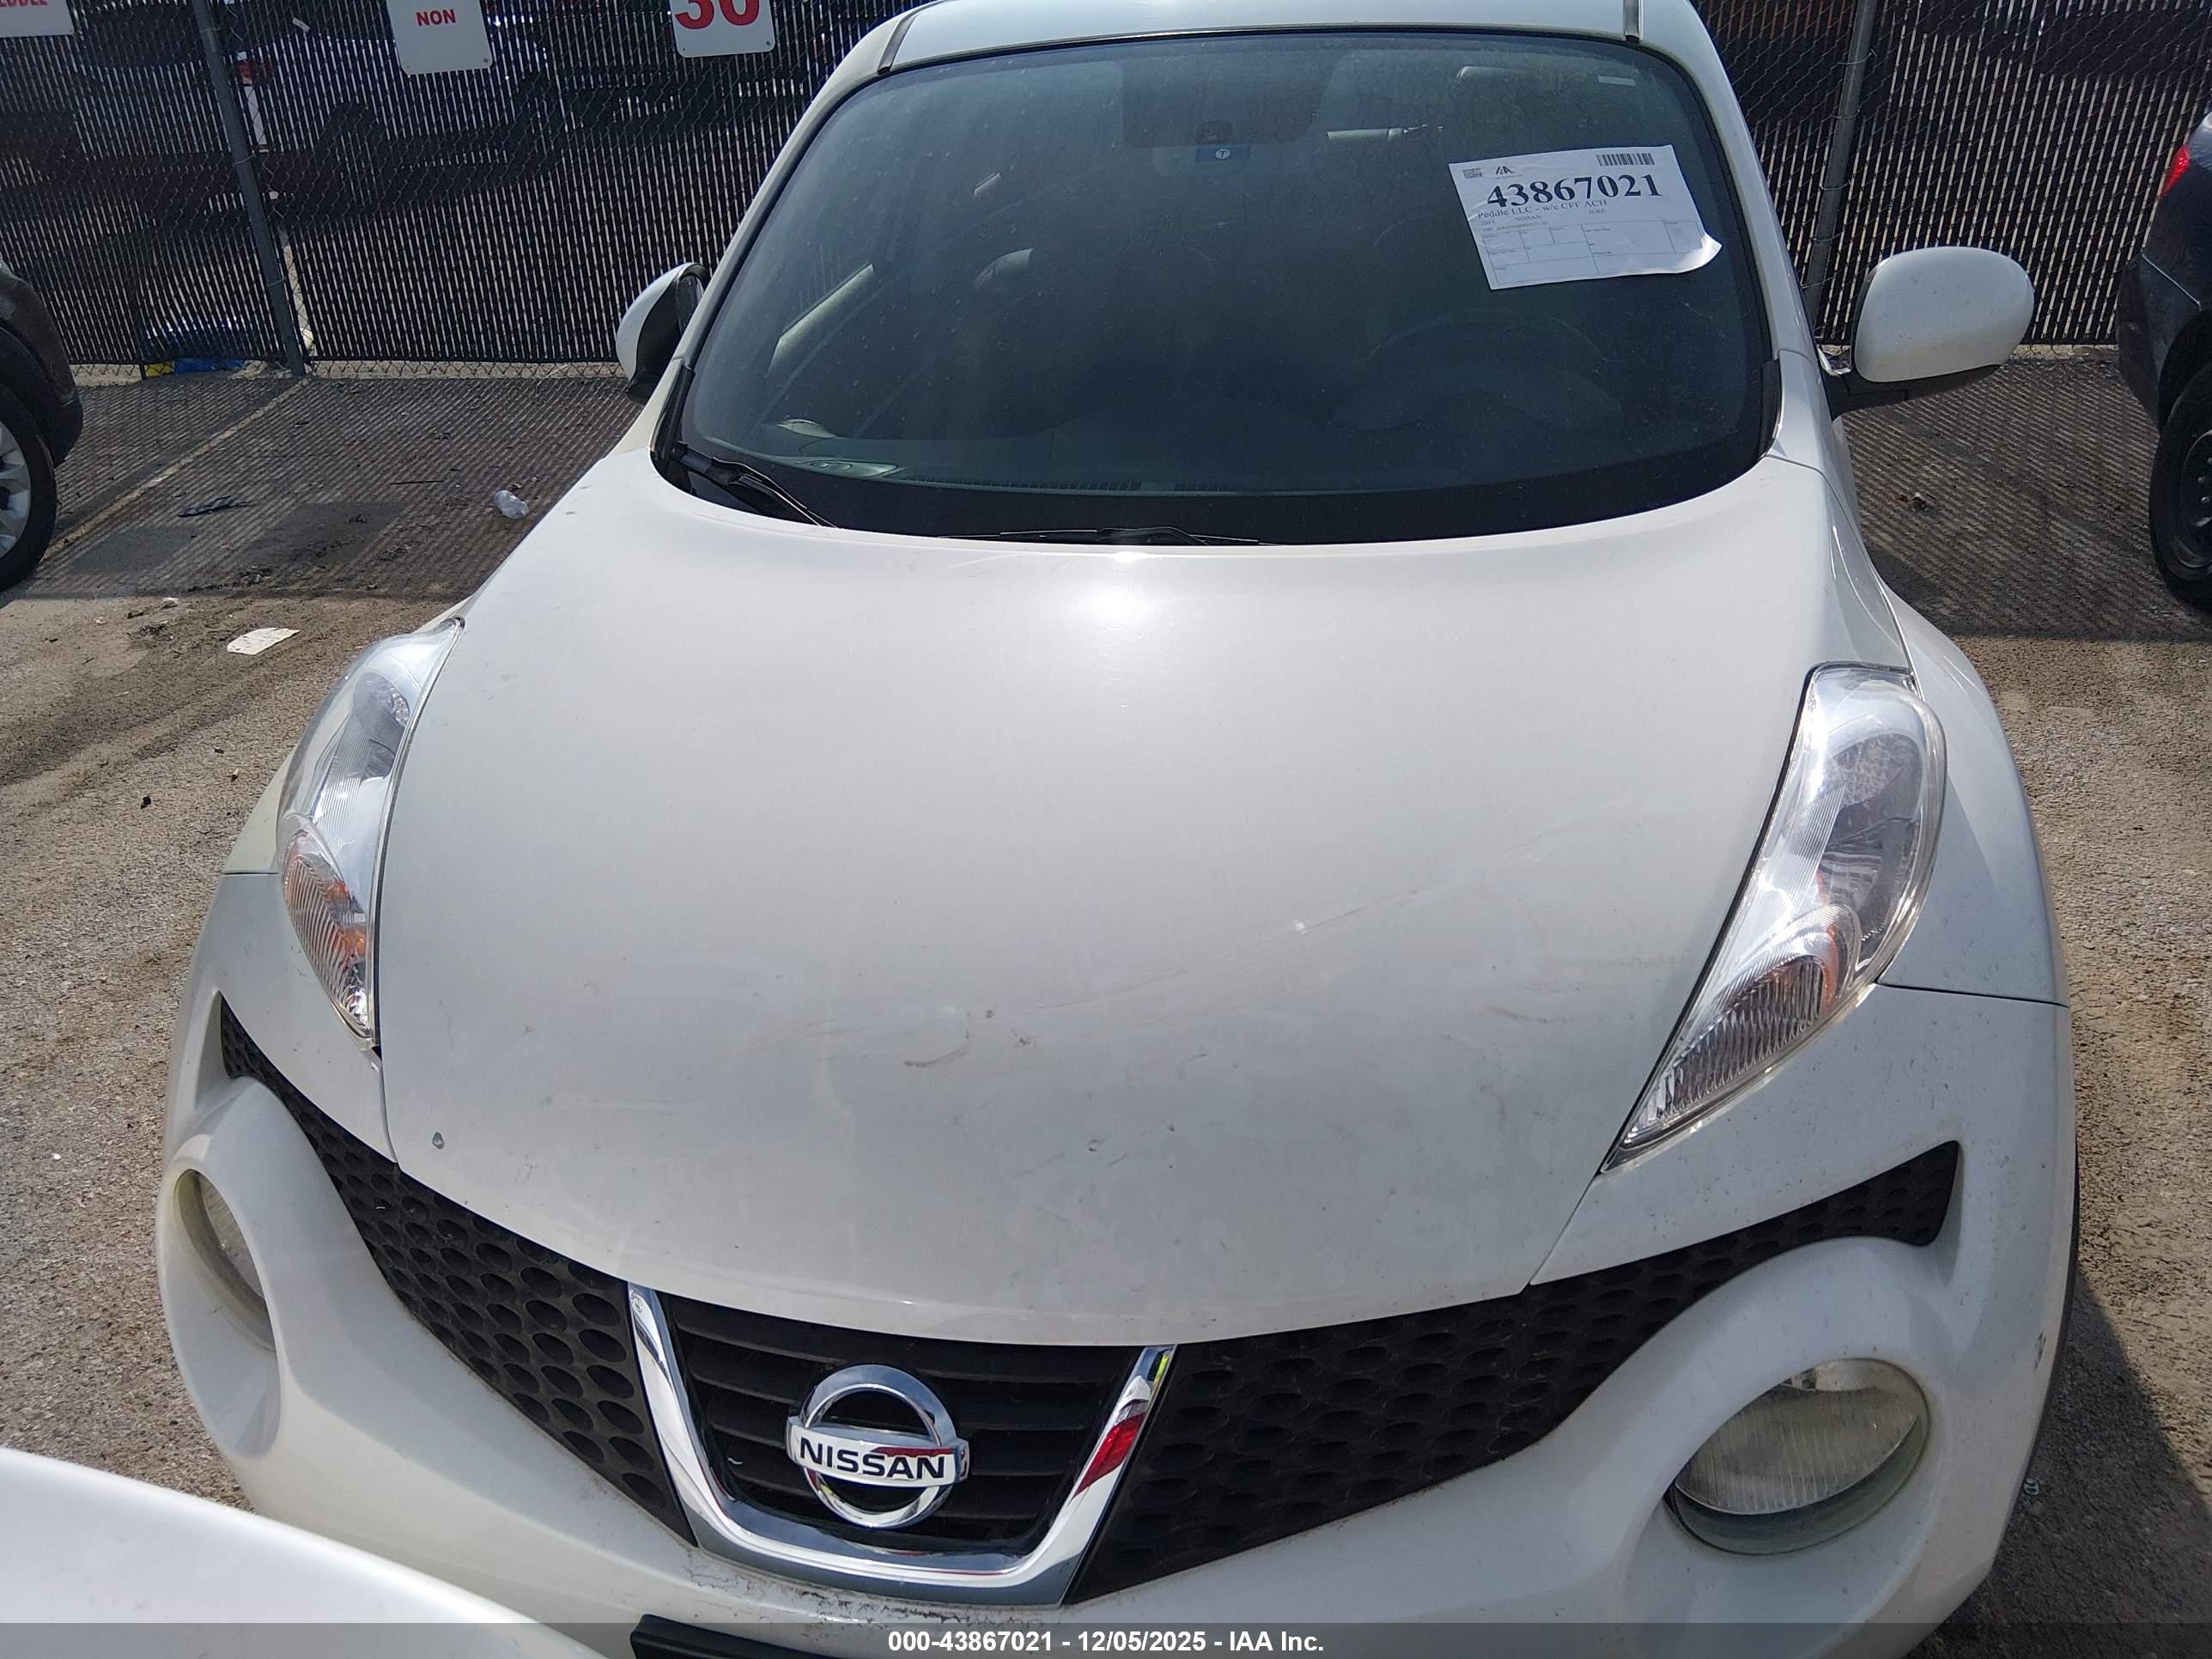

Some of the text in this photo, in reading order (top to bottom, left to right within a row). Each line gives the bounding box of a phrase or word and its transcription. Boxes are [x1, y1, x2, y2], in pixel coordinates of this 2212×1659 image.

[416, 9, 456, 27] NON
[675, 0, 760, 29] 30
[1486, 173, 1662, 208] 43867021
[800, 1437, 945, 1480] NISSAN
